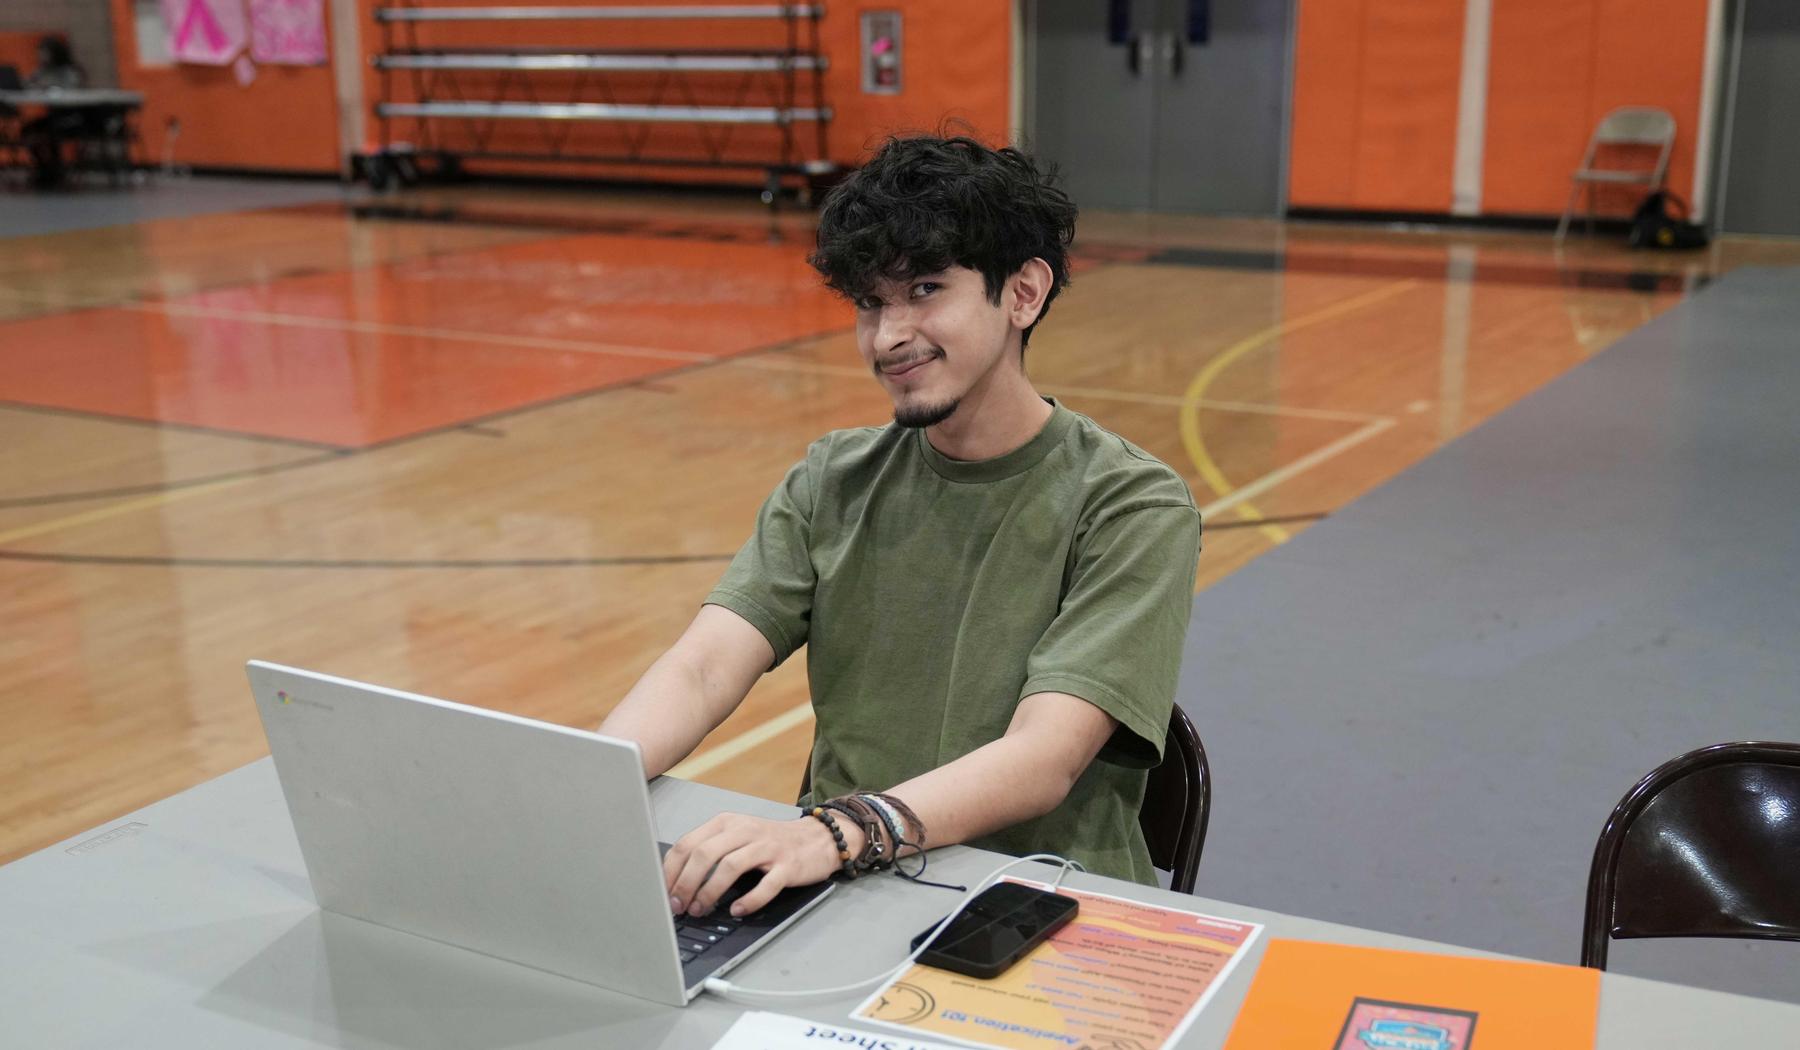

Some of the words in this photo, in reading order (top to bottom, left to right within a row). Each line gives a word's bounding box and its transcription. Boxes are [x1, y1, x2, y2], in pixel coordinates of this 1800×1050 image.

[939, 1009, 968, 1023] 101
[802, 1026, 897, 1050] Sheet
[973, 1016, 1080, 1046] Application
